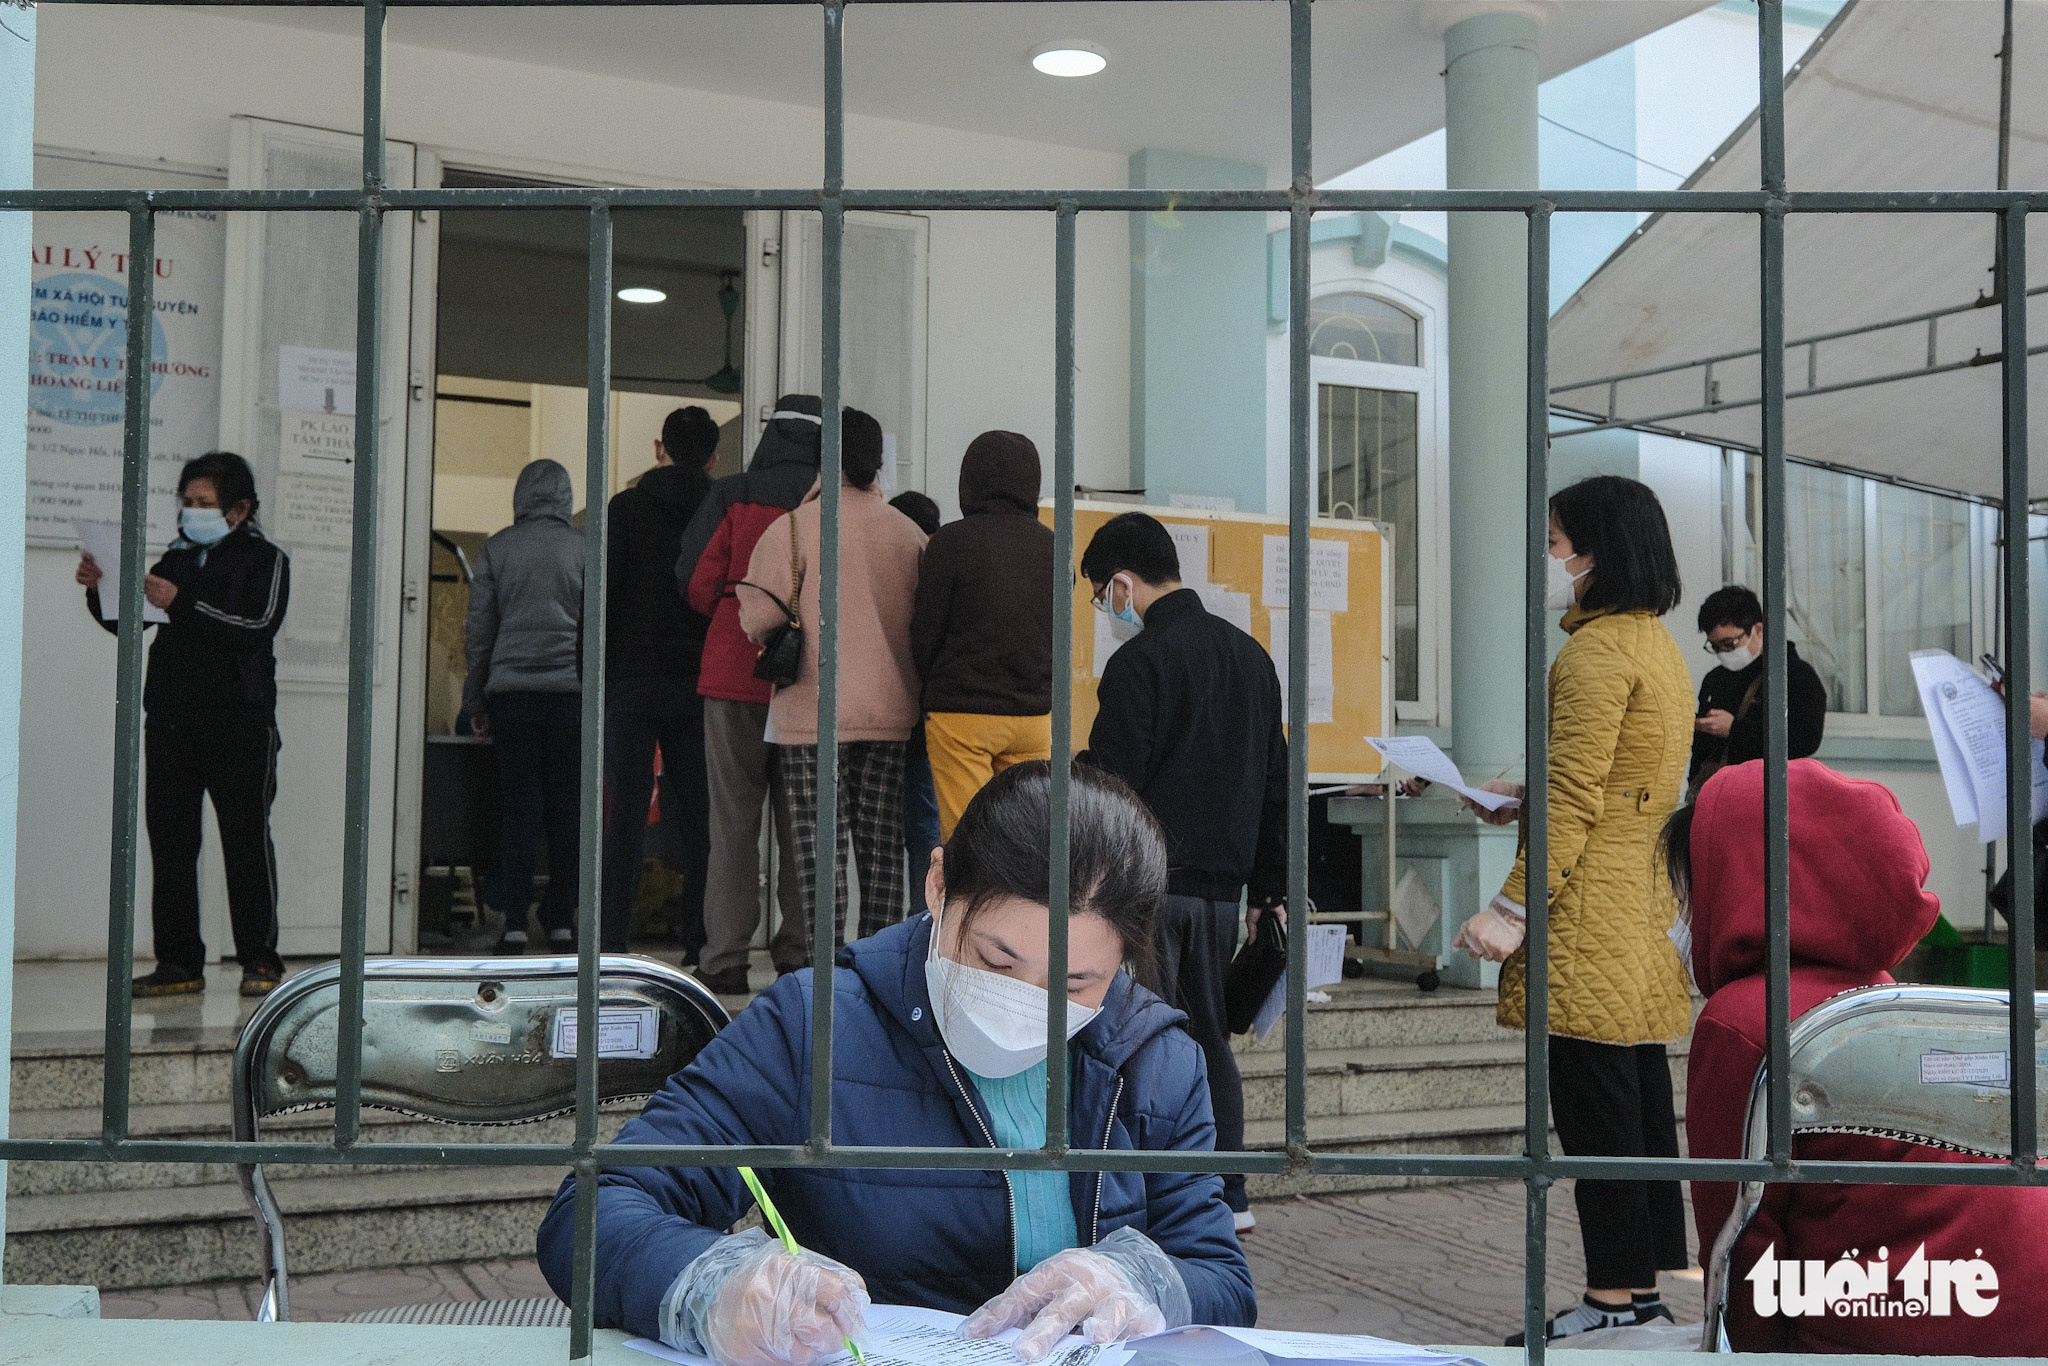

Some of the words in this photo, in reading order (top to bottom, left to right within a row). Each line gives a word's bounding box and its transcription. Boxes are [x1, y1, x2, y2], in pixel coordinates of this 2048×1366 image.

[63, 245, 101, 269] LÝ
[111, 252, 174, 278] TU
[108, 319, 117, 329] Y
[101, 357, 110, 369] Y
[150, 361, 210, 378] HƯỜNG
